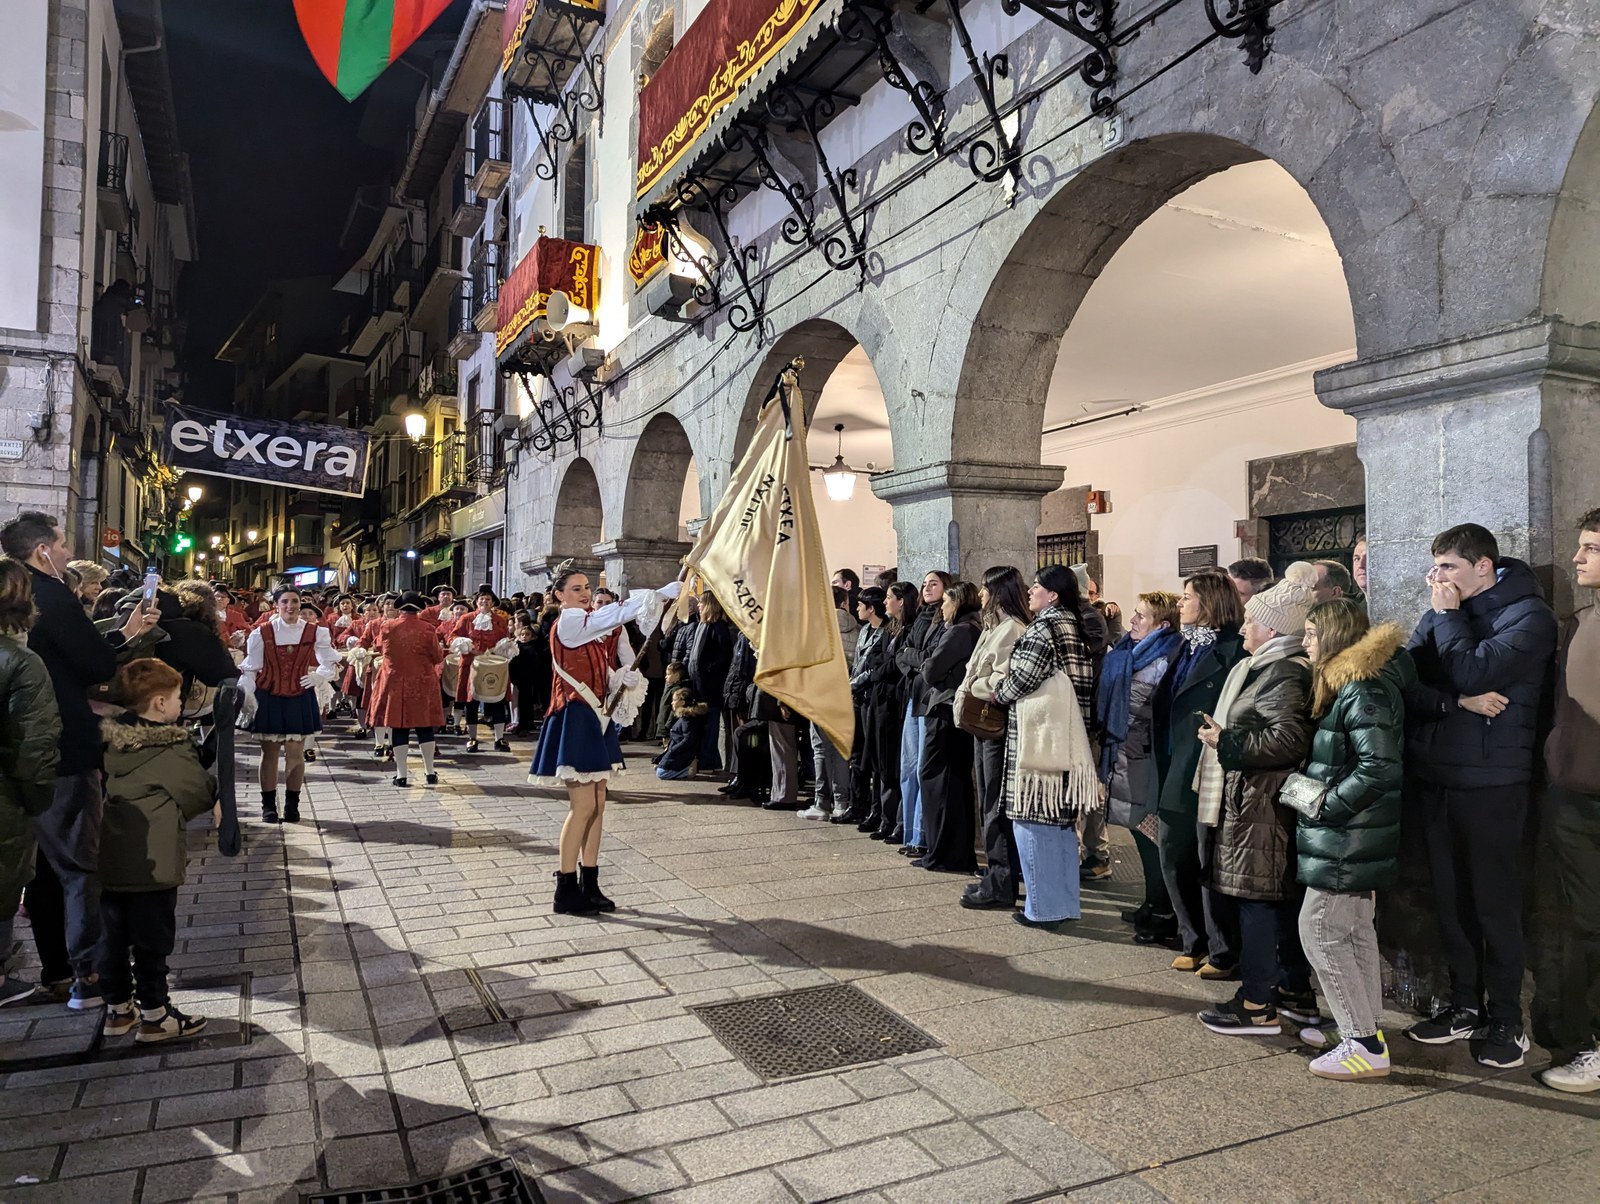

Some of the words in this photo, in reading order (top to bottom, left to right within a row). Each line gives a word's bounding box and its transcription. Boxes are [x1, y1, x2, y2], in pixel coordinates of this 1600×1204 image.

[1107, 118, 1117, 142] 5
[171, 420, 357, 477] etxera
[740, 473, 775, 531] JULIAN
